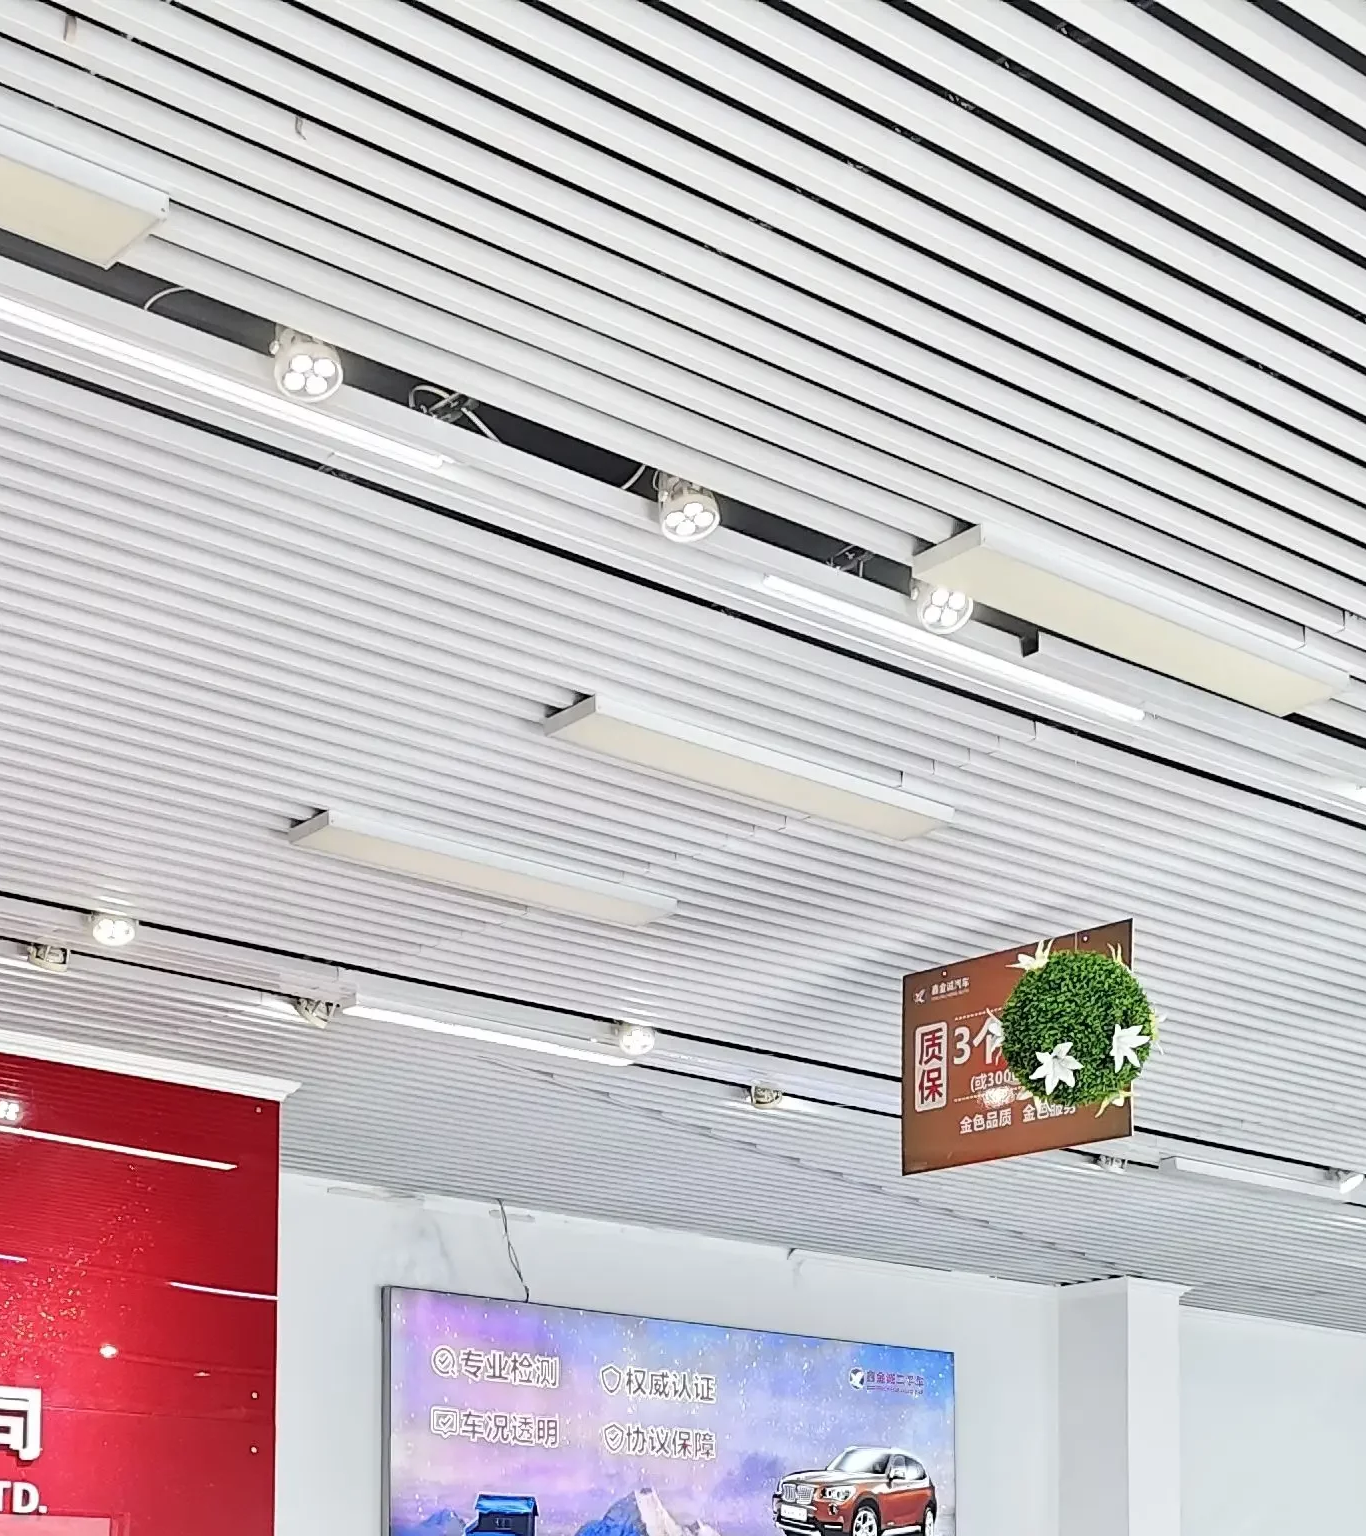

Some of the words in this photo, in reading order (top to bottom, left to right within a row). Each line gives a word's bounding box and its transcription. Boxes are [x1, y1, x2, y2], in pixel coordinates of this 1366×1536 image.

[918, 1027, 943, 1103] 质保
[959, 1109, 1012, 1135] 金色品质
[460, 1348, 559, 1388] 专业检测
[625, 1368, 716, 1403] 权威认证
[460, 1410, 559, 1447] 车况透明
[625, 1426, 716, 1460] 协议保障
